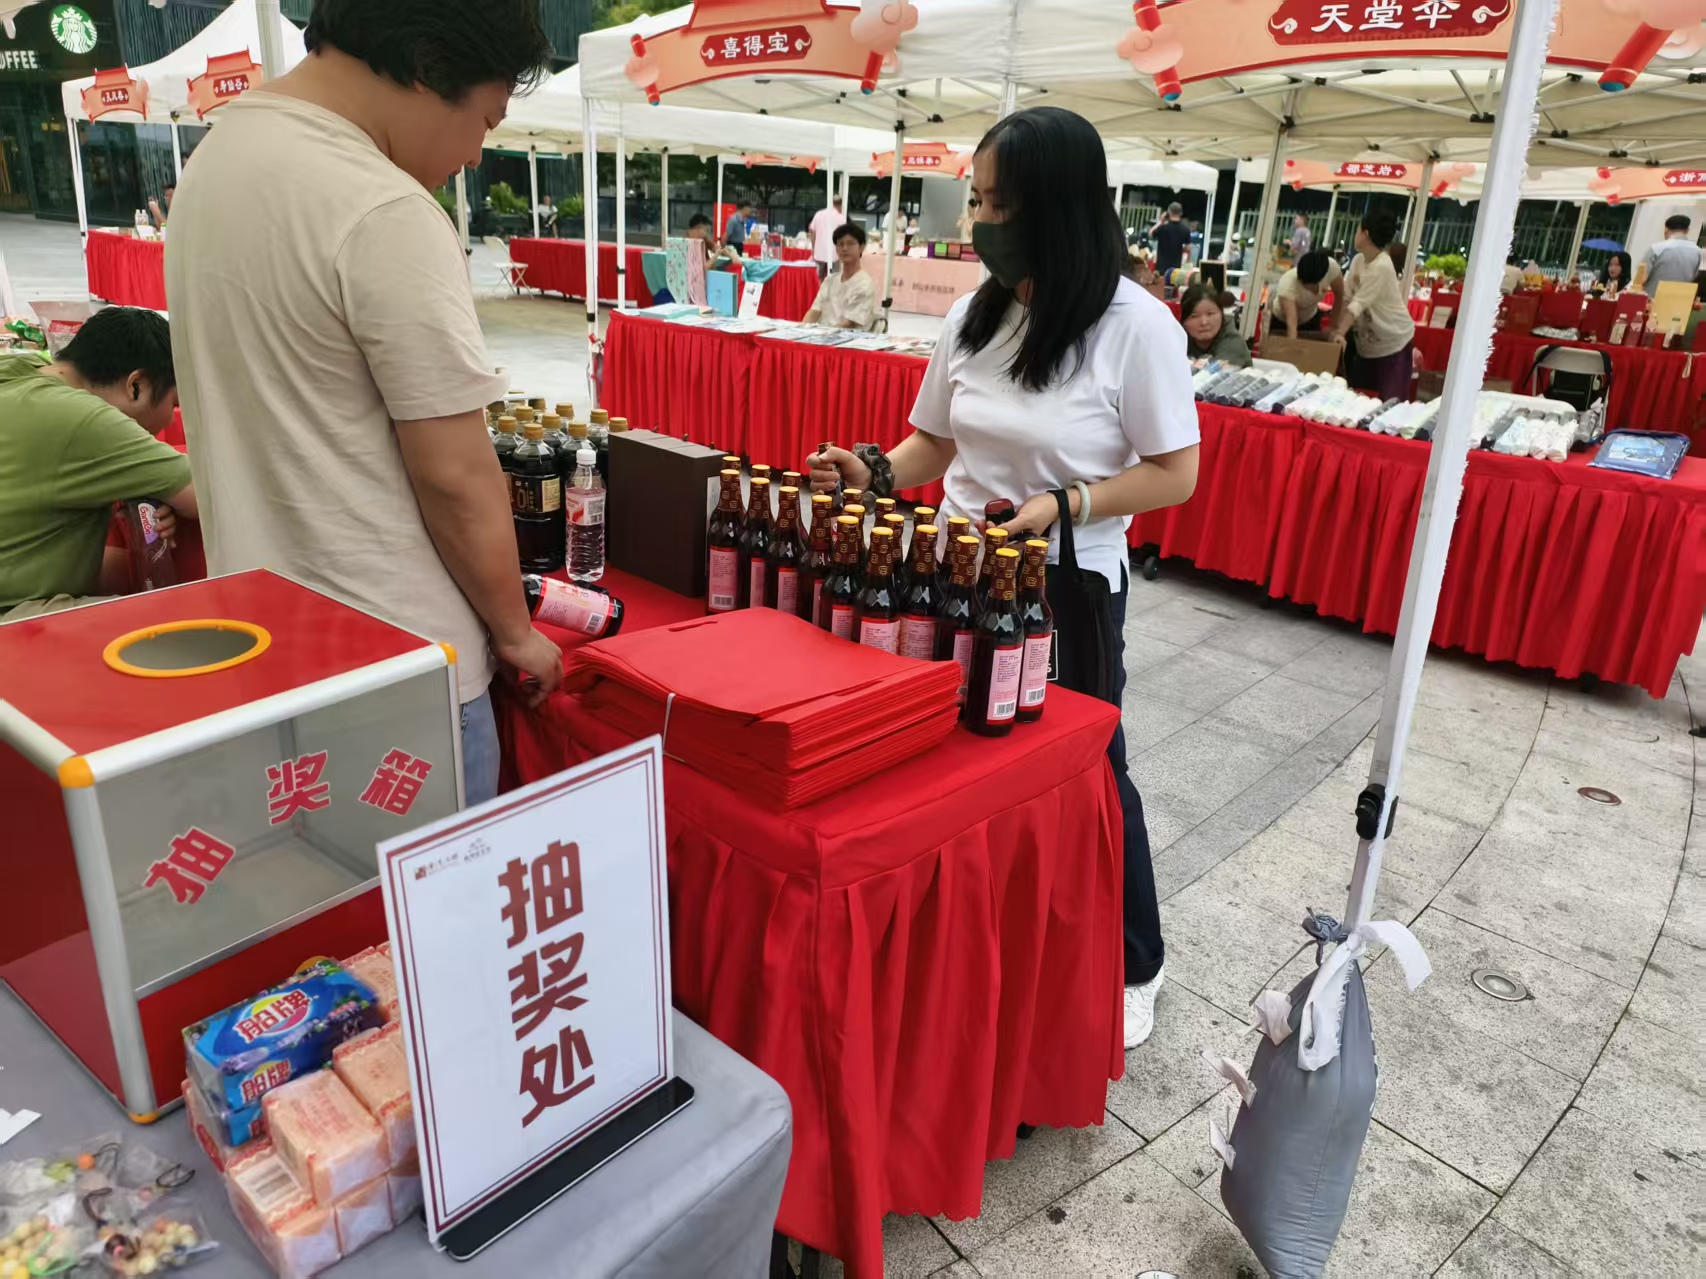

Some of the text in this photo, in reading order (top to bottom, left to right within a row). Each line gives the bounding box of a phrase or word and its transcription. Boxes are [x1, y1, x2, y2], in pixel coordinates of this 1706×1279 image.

[1310, 0, 1461, 33] 天堂伞
[720, 31, 790, 59] 喜得宝
[144, 748, 433, 904] 抽奖箱
[497, 839, 596, 1129] 抽奖处
[234, 988, 311, 1043] 船牌
[239, 1059, 290, 1103] 船牌
